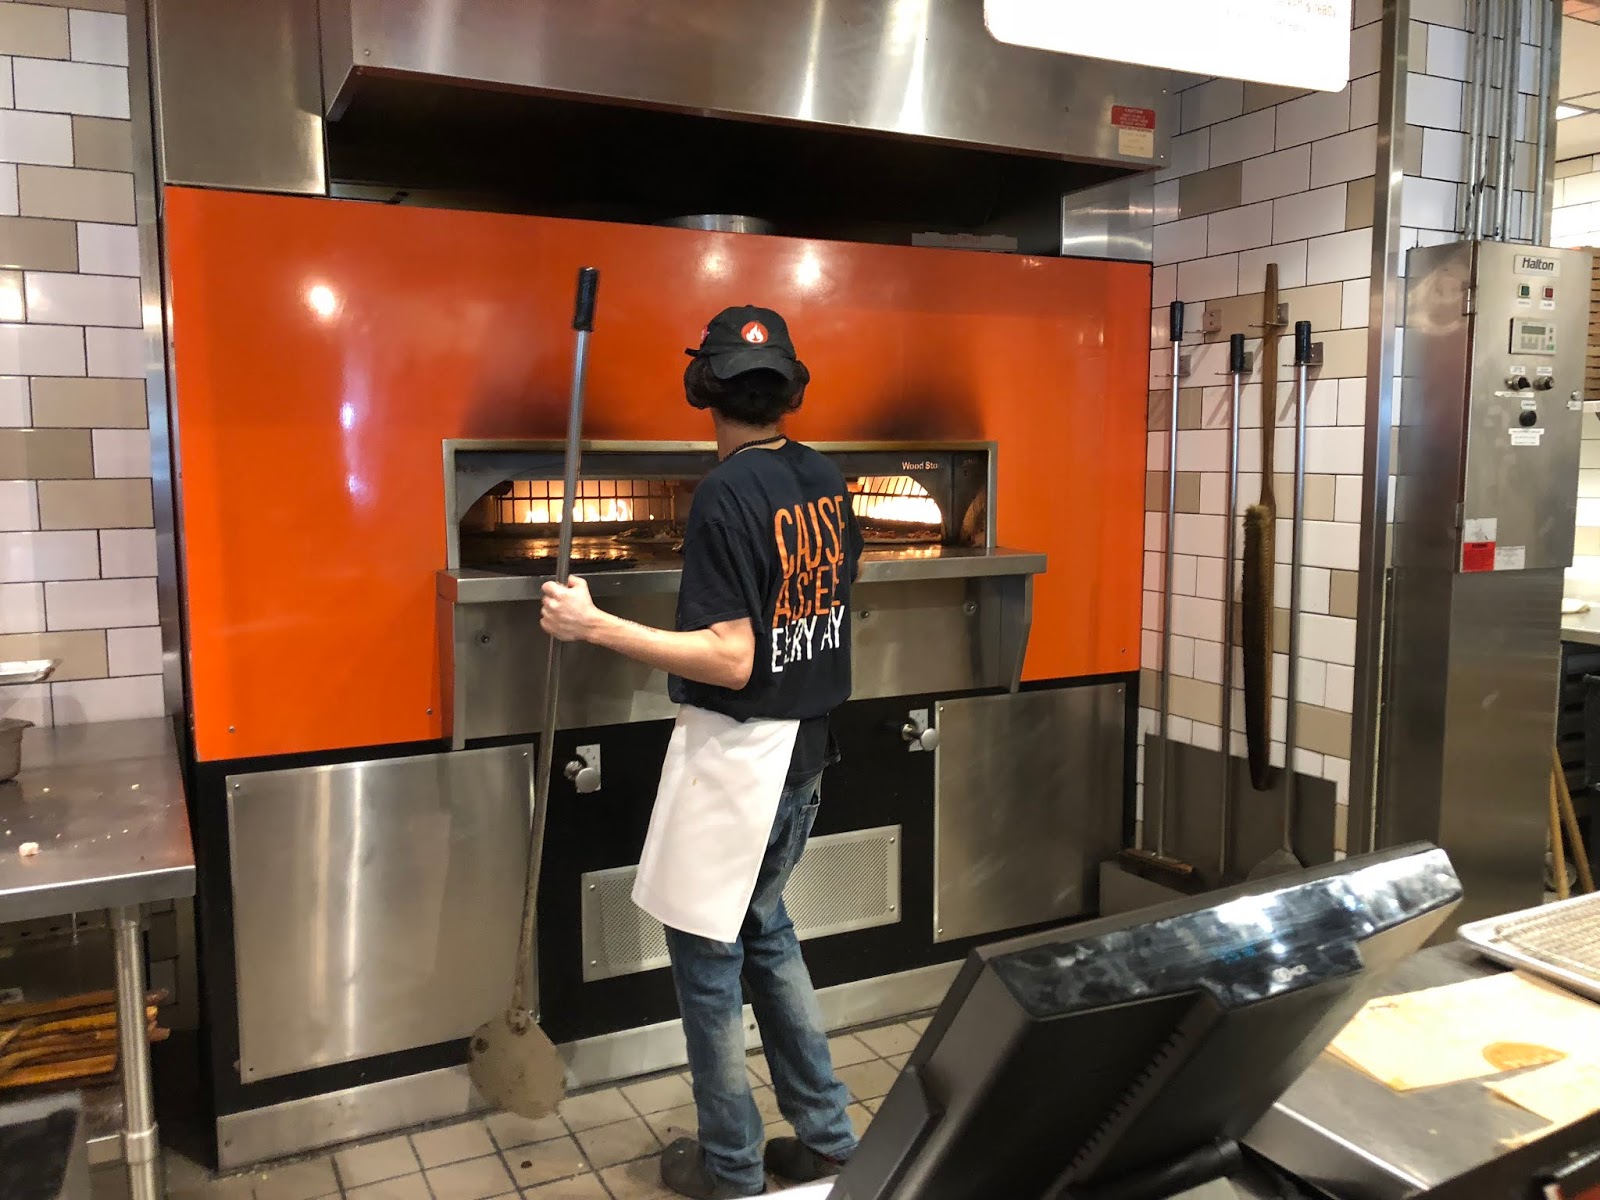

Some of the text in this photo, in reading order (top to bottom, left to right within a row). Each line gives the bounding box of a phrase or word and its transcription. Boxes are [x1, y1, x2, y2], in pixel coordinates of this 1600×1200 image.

[1521, 257, 1554, 271] Halton
[901, 461, 945, 470] Wood Sto
